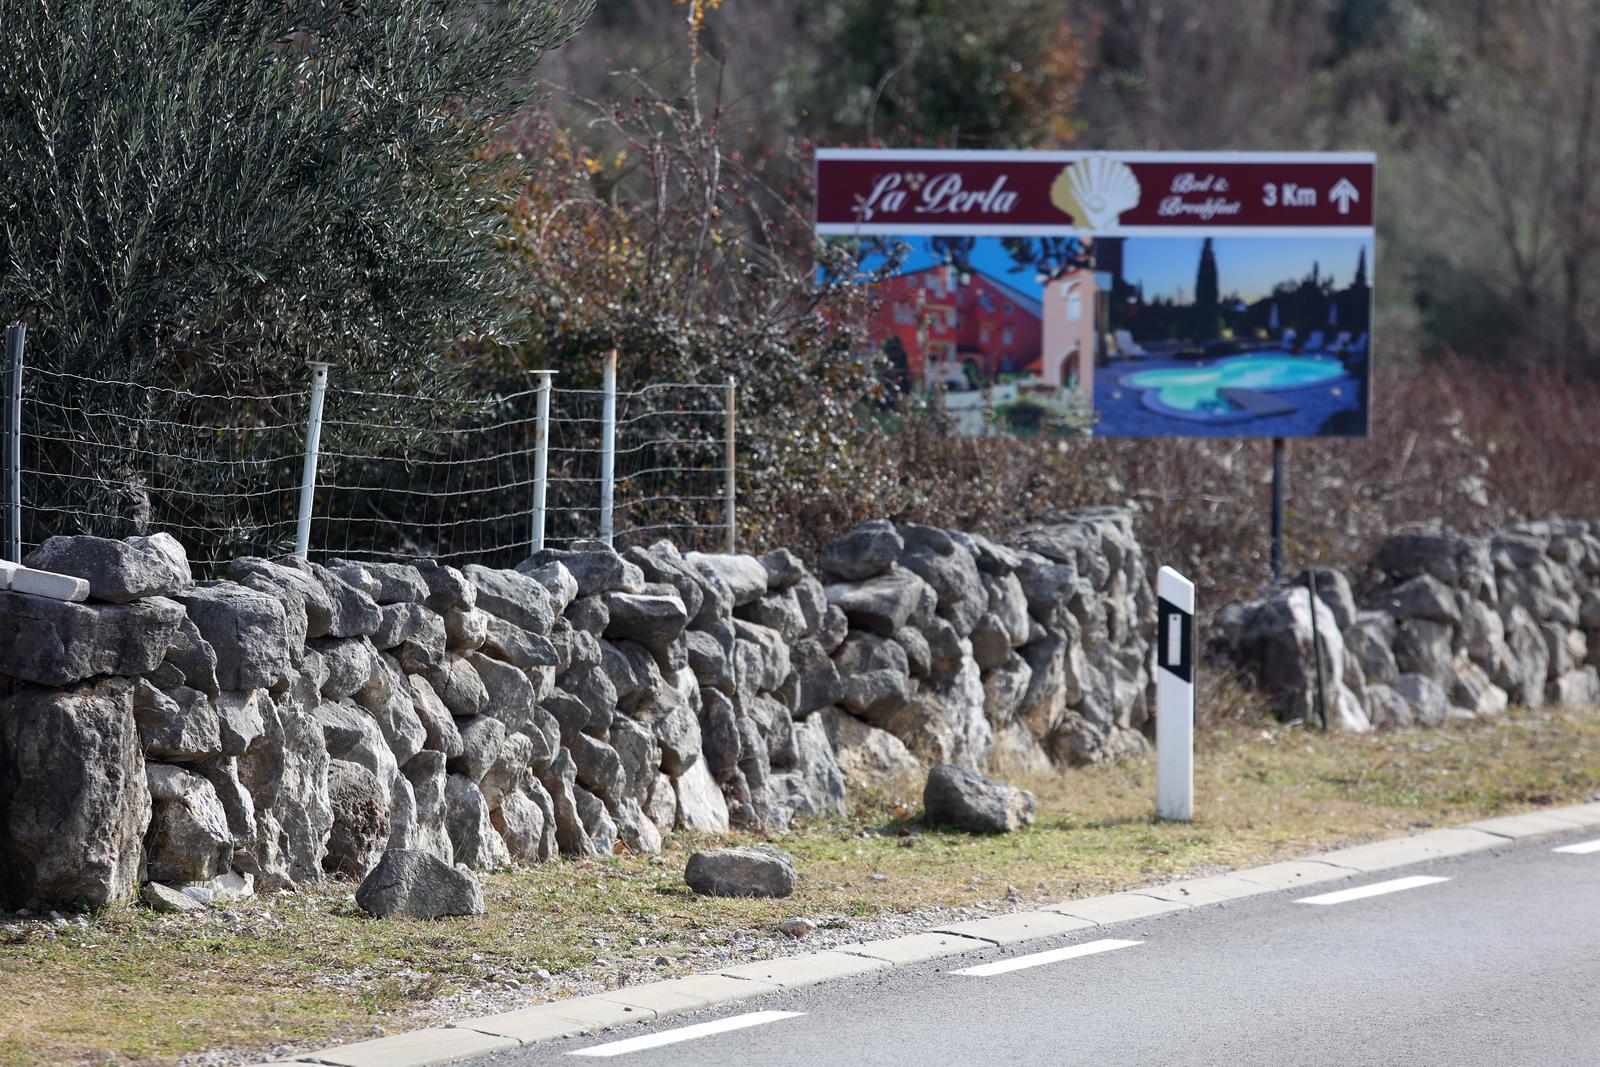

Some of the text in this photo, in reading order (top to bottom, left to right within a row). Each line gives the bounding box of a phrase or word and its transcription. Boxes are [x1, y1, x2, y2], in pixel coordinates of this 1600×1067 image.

[1170, 172, 1229, 193] Bed &
[851, 172, 1018, 221] La Perla
[1262, 183, 1317, 207] 3 Km
[1157, 195, 1241, 220] Breakfast
